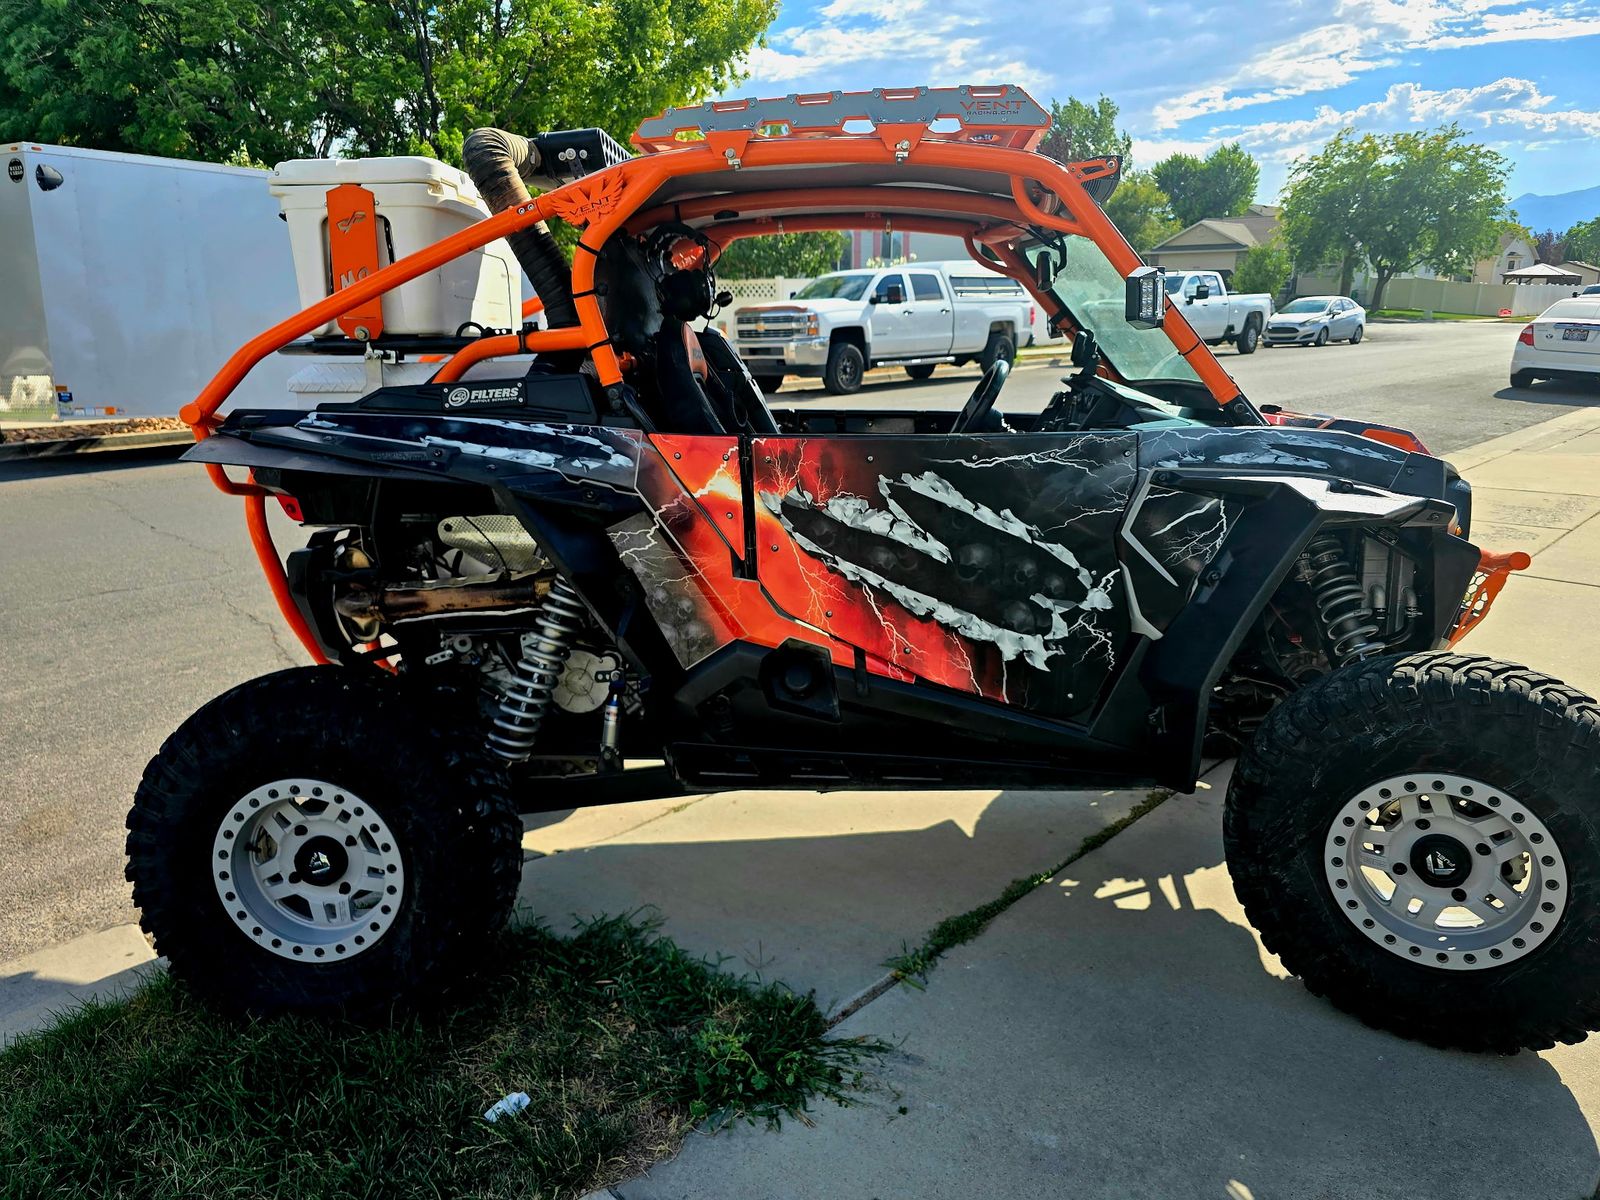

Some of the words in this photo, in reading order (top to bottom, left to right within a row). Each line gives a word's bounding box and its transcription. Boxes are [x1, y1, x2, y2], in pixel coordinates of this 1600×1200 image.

[960, 101, 1026, 110] VENT
[569, 195, 612, 216] VENT
[471, 387, 519, 400] FILTERS
